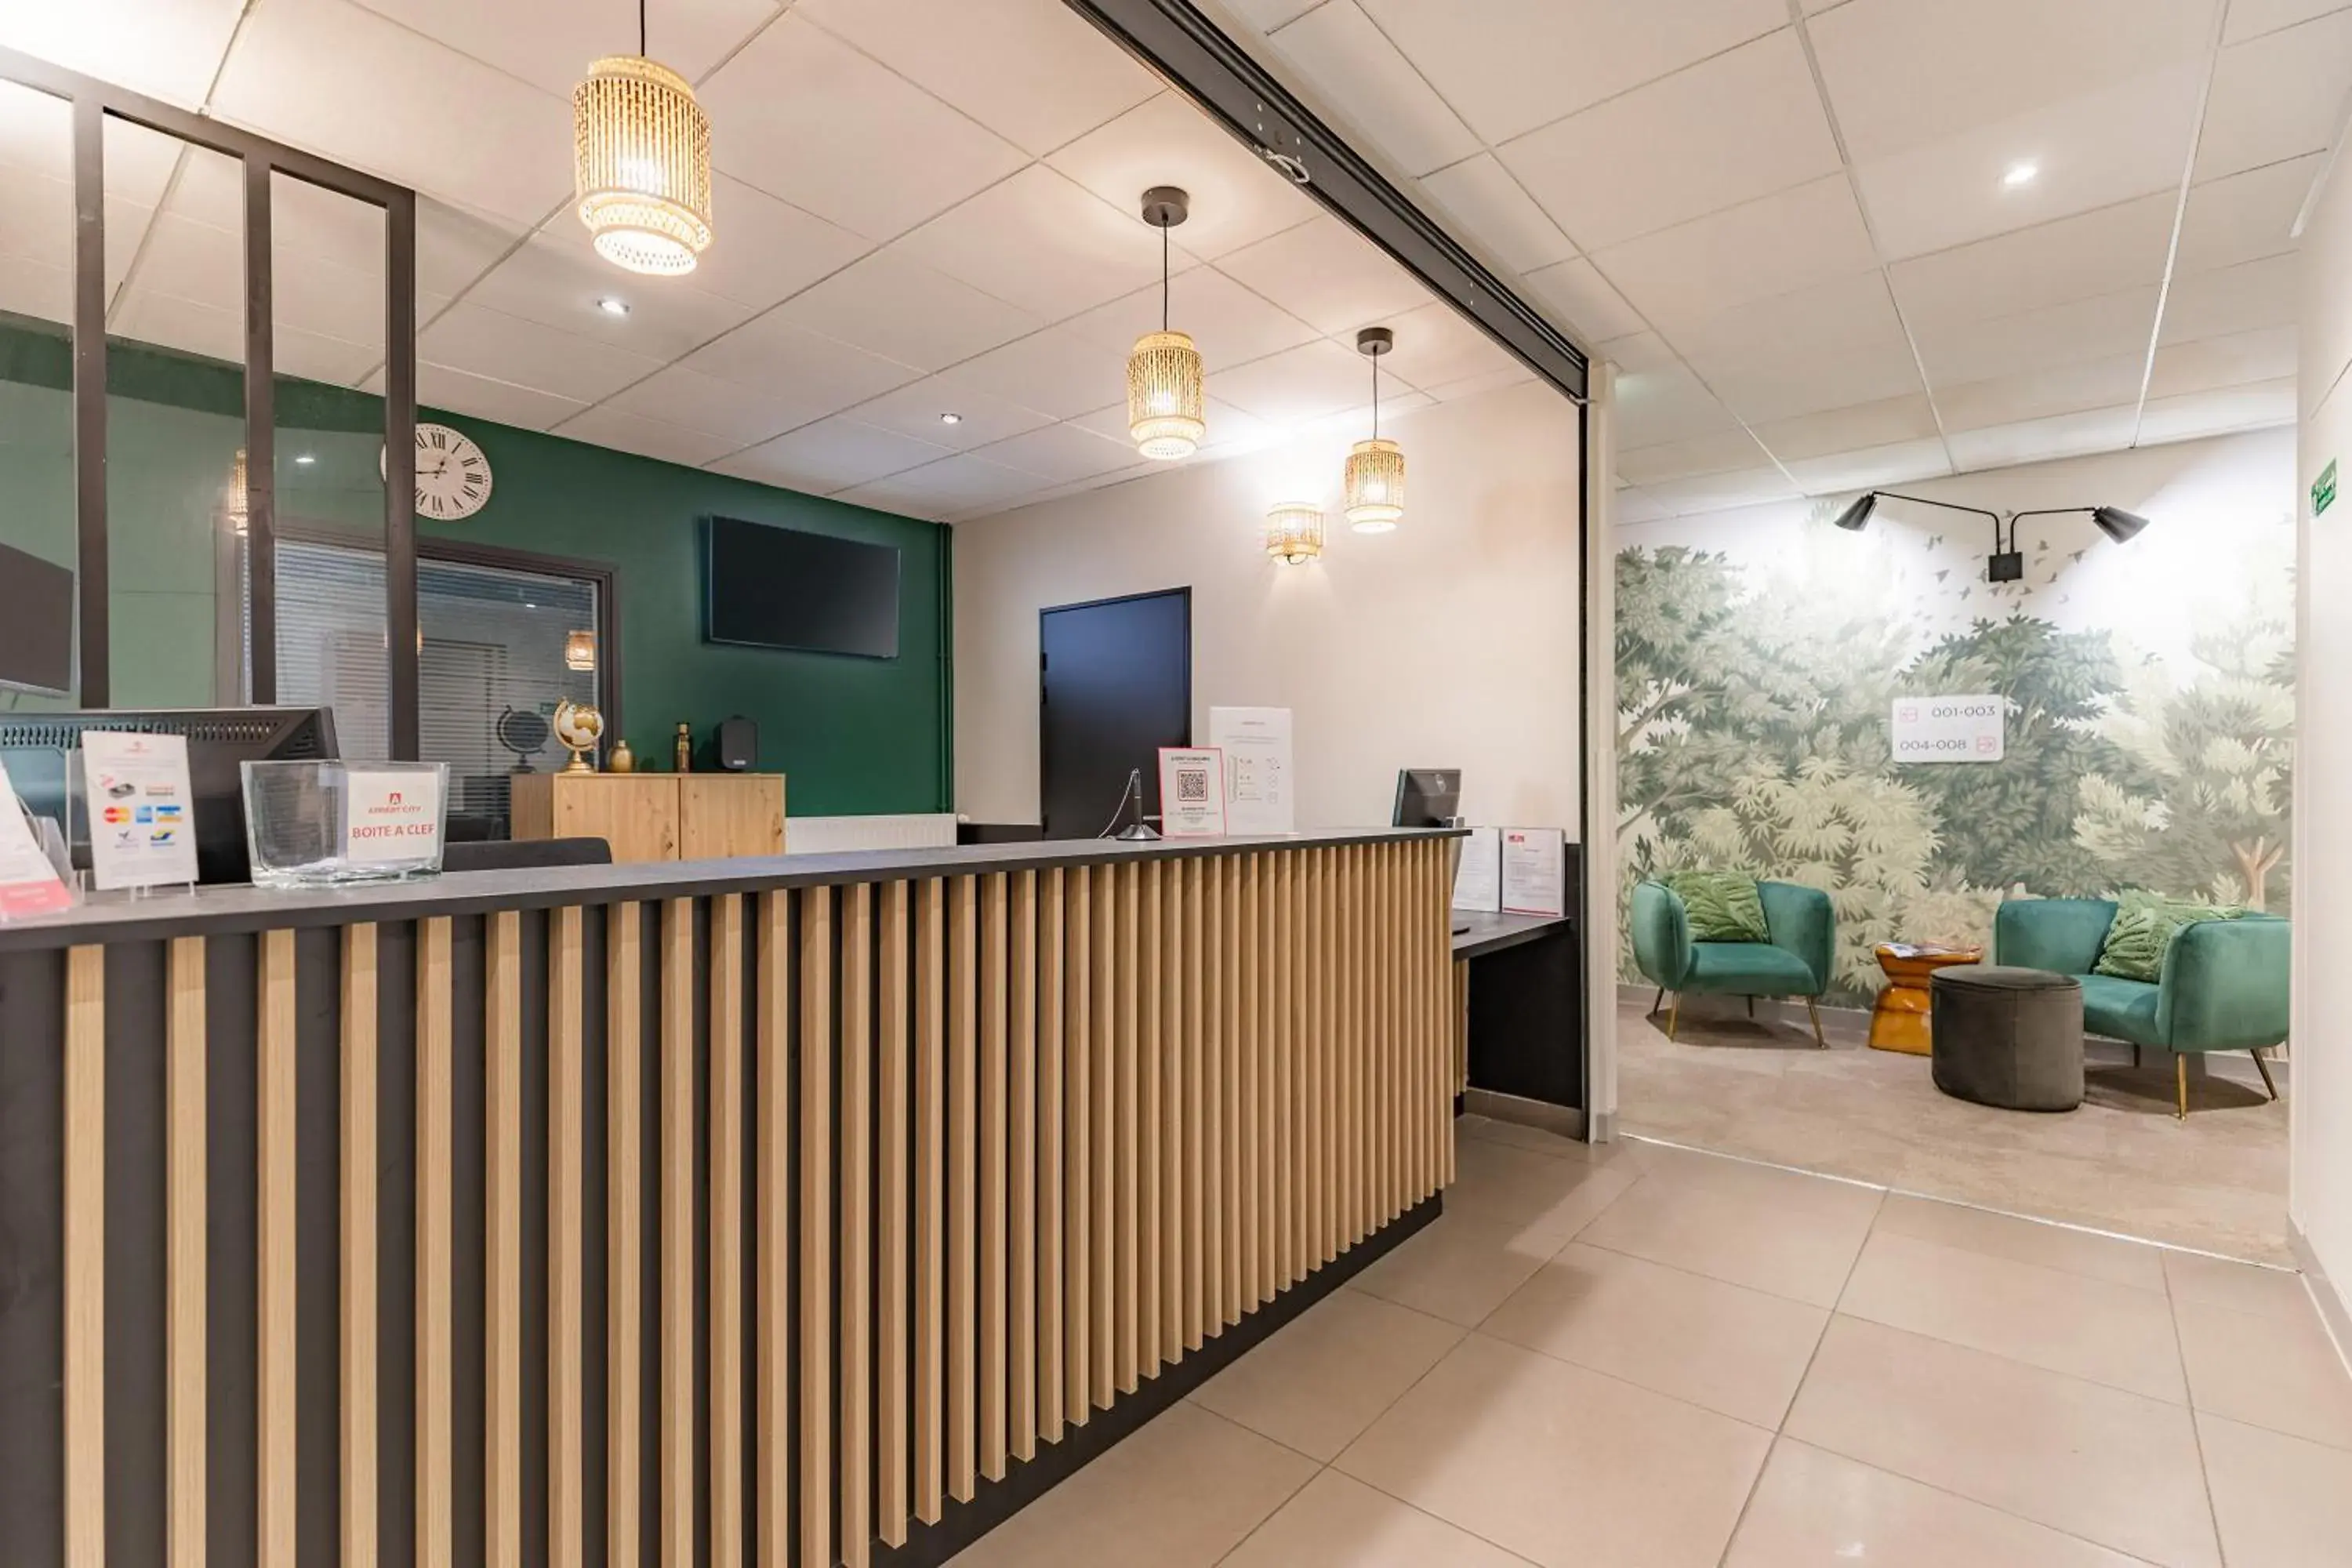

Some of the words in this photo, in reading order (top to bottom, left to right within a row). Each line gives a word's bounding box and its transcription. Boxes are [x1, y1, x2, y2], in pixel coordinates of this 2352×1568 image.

[430, 432, 445, 449] XII
[466, 473, 483, 485] III
[1932, 706, 1995, 717] 001-003
[1900, 739, 1967, 750] 004-008
[352, 826, 390, 838] BOITE
[394, 826, 403, 837] A
[407, 823, 435, 834] CLEF
